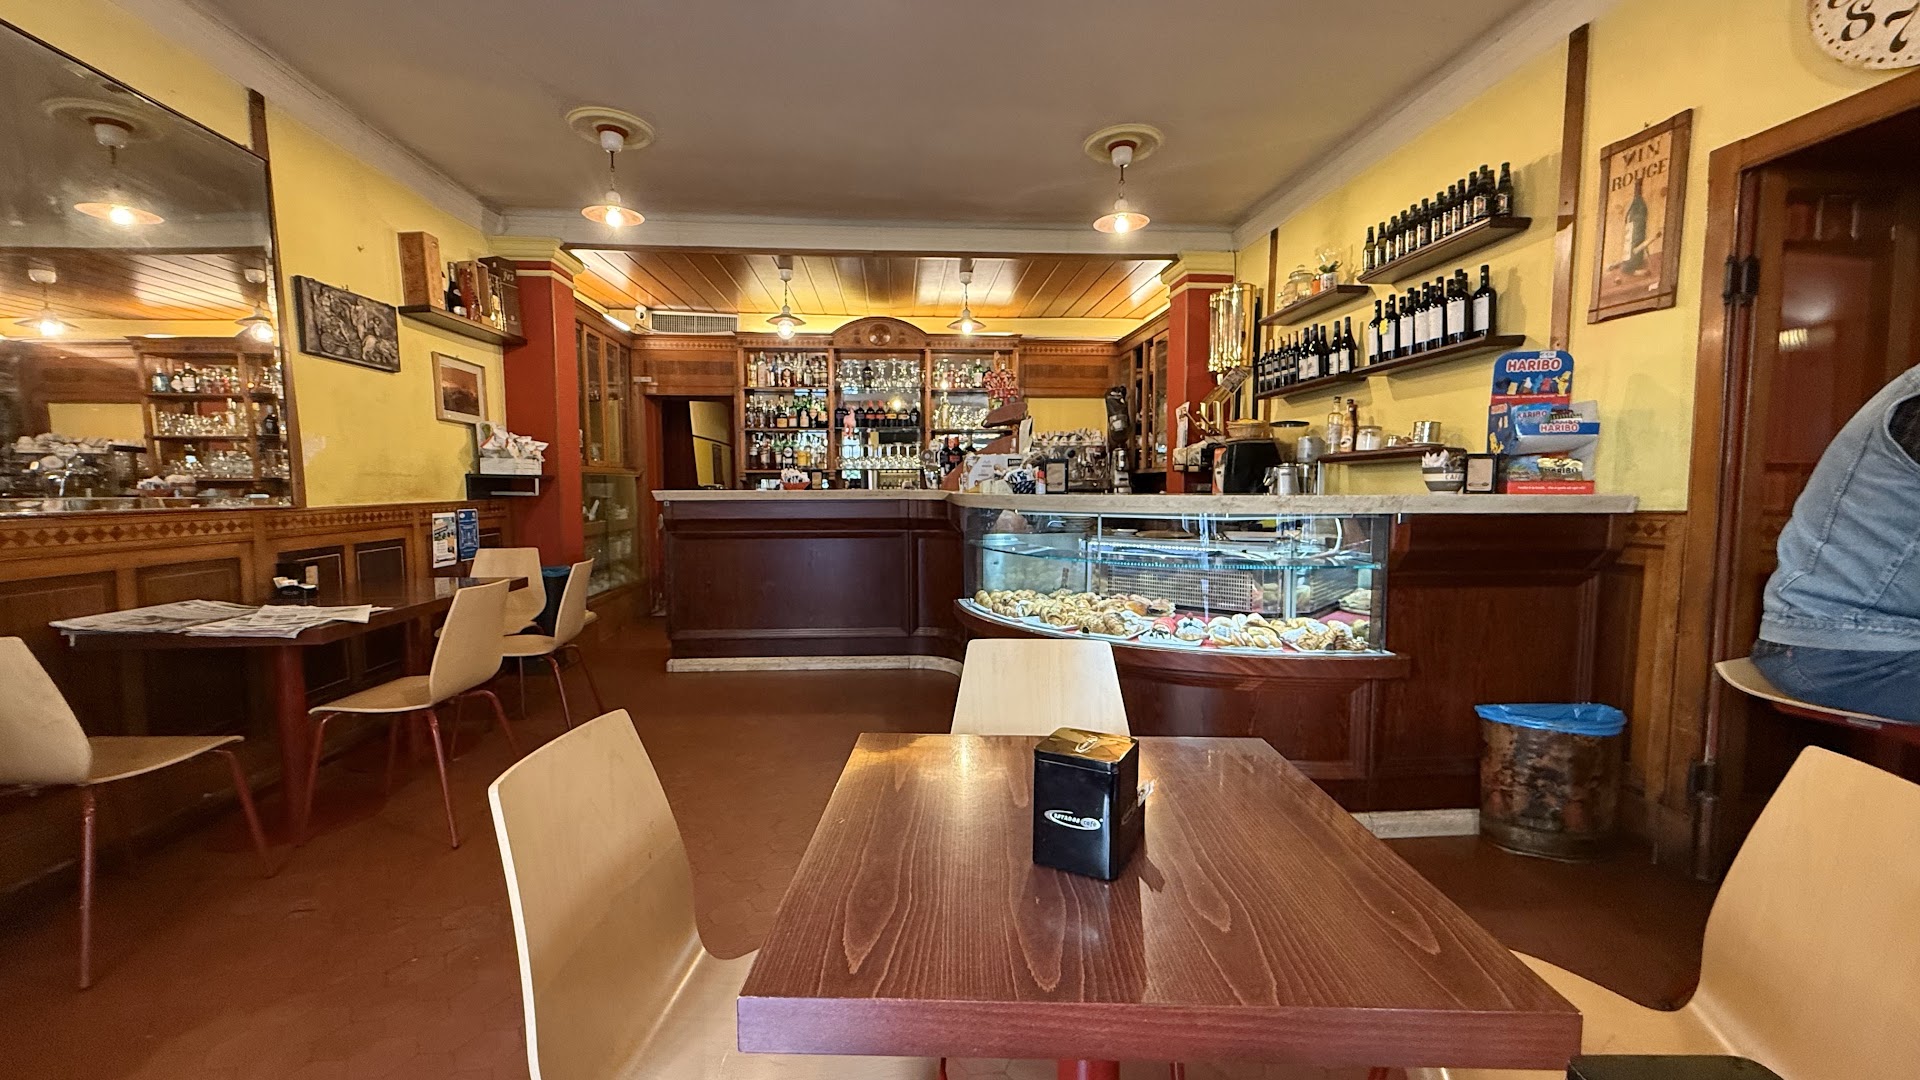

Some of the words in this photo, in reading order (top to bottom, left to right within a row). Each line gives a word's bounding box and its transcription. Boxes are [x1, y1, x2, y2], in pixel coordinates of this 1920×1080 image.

[1622, 138, 1662, 167] VIN
[1611, 157, 1668, 191] ROUGE
[1506, 358, 1562, 372] HARIBO
[1539, 423, 1579, 433] HARIBO
